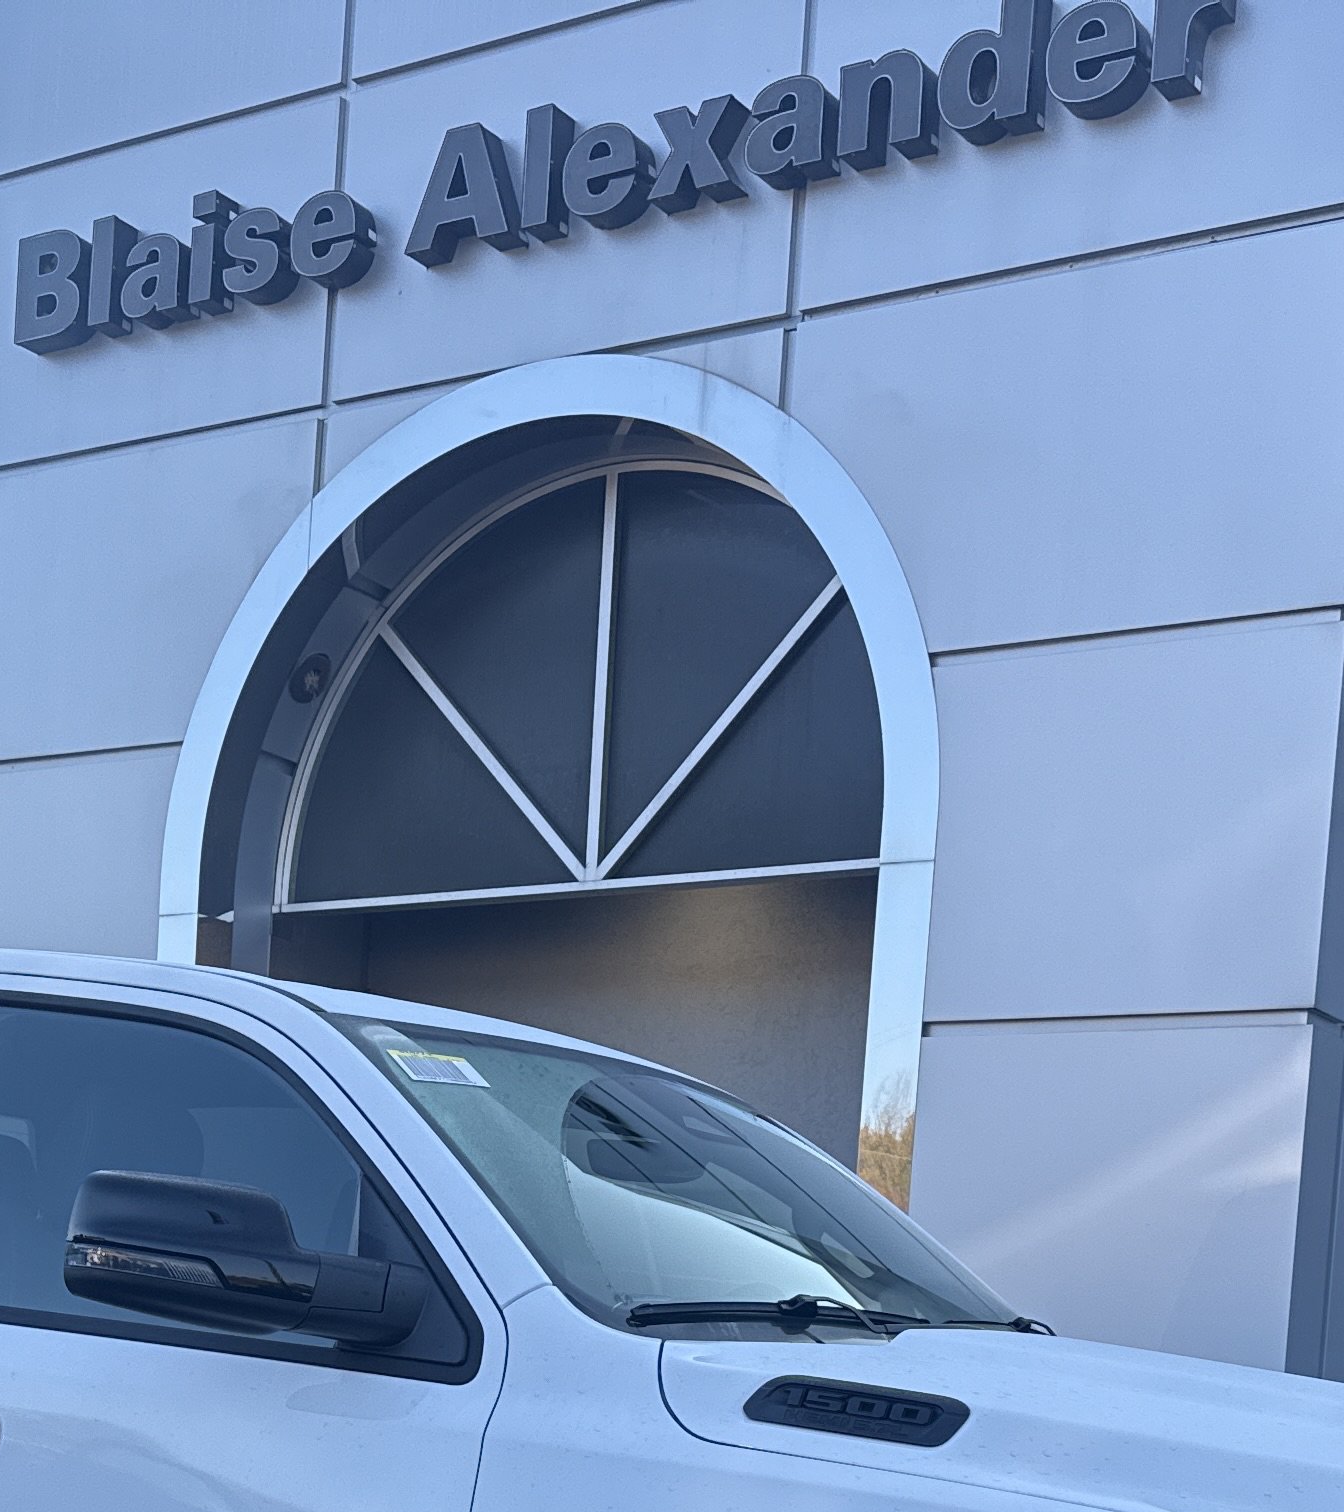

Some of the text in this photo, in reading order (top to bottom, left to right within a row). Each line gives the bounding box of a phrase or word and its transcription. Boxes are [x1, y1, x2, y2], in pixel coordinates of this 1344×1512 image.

[14, 0, 1236, 355] Blaise Alexander
[780, 1387, 933, 1425] 1500
